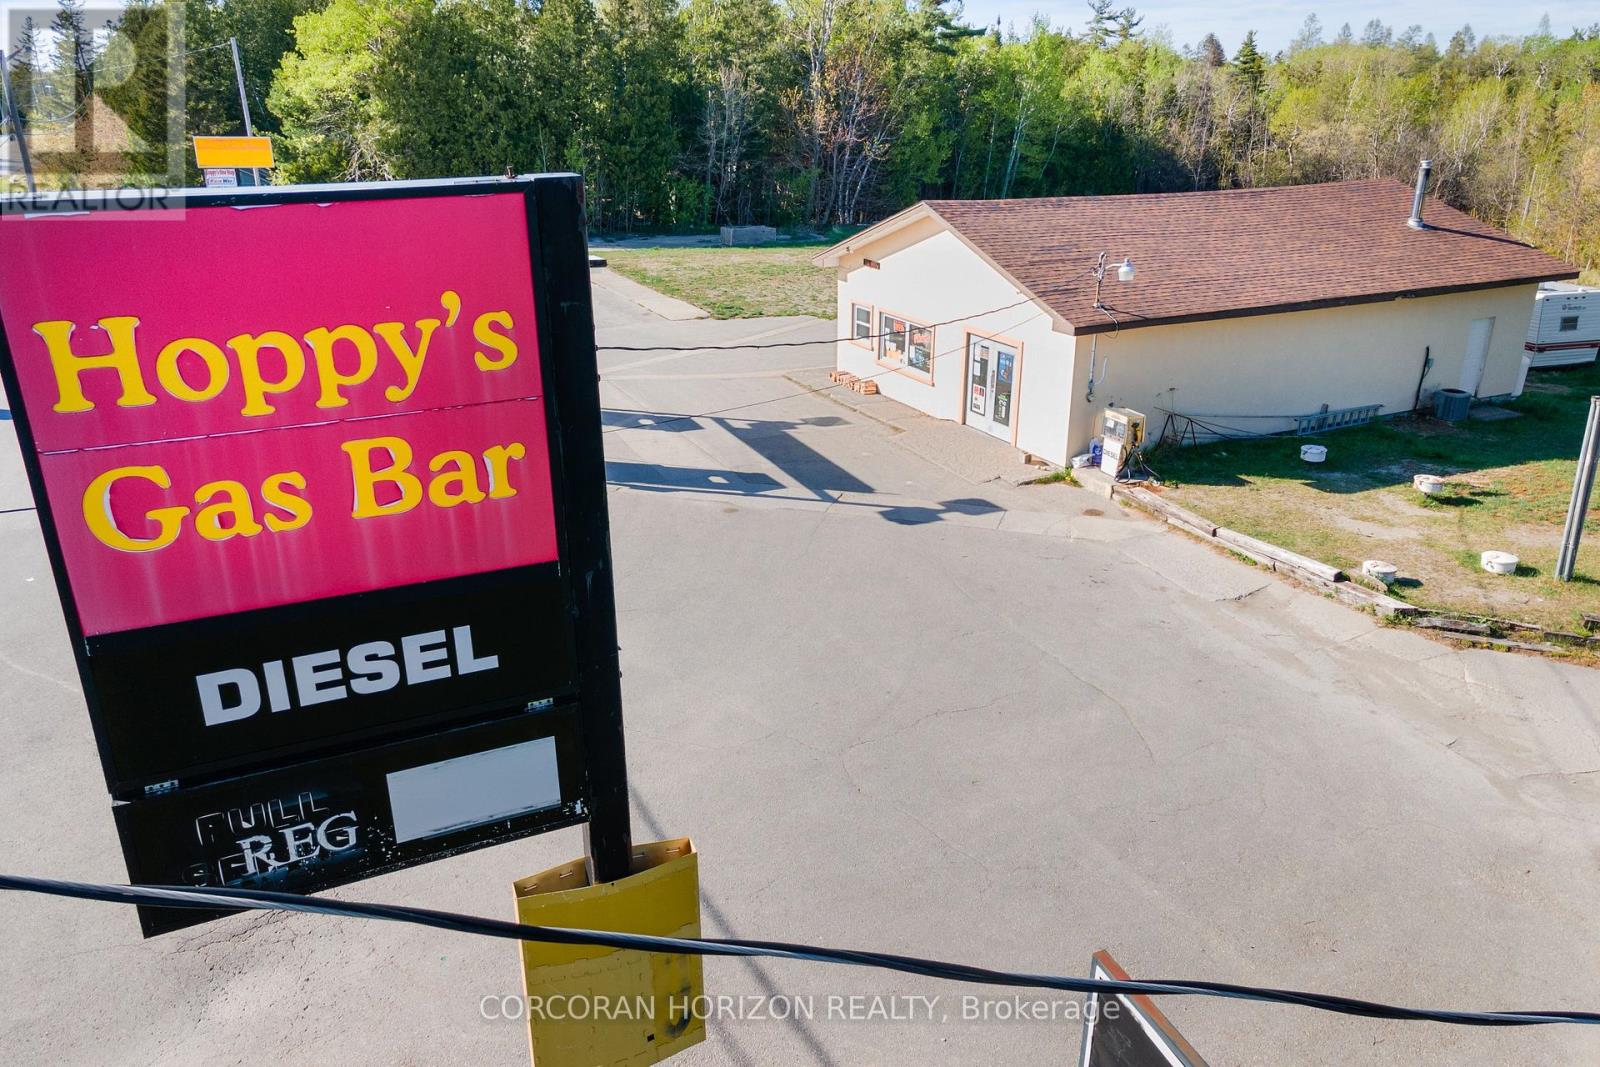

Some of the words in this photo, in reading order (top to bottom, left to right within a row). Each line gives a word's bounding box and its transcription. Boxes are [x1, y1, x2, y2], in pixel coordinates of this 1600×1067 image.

[31, 290, 520, 417] Hoppy's
[82, 464, 313, 553] Gas
[341, 436, 526, 519] Bar
[195, 625, 499, 727] DIESEL
[236, 810, 359, 876] REG
